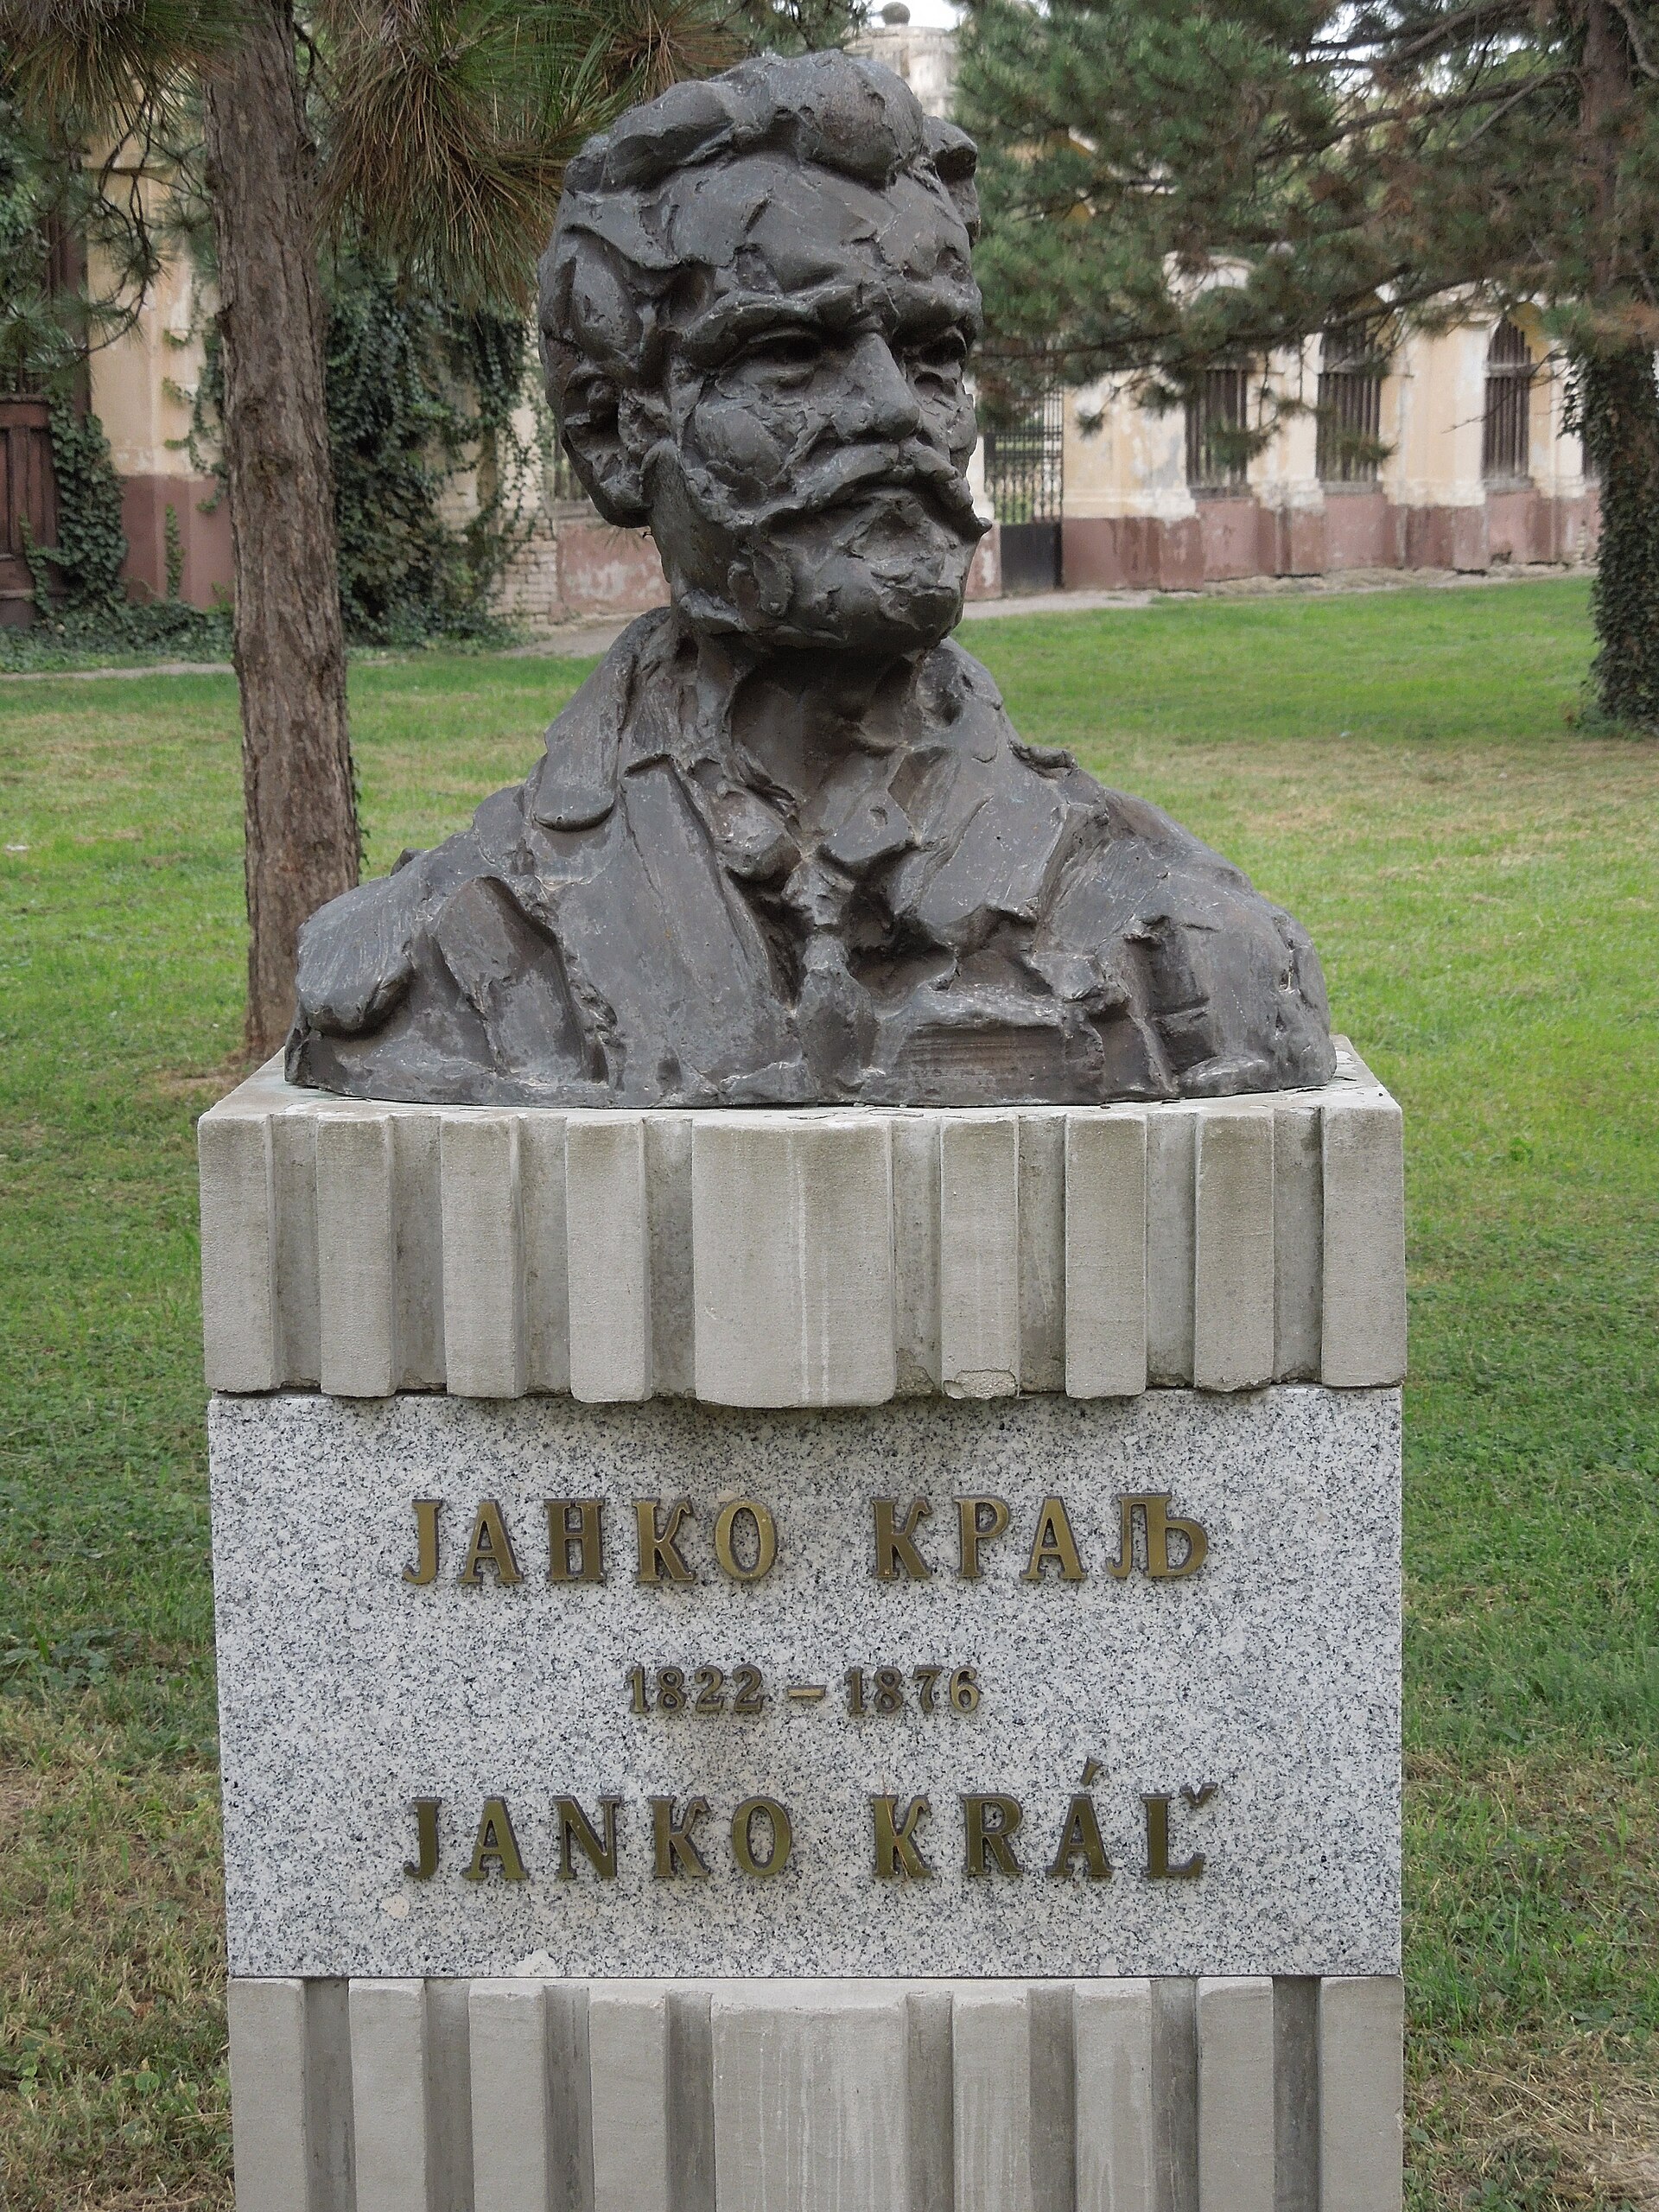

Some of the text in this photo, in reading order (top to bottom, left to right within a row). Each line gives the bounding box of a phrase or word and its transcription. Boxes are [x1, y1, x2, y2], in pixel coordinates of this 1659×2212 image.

[403, 1491, 1211, 1585] ЈАНКО КРАЉ
[626, 1663, 765, 1713] 1822
[843, 1664, 981, 1714] 1876
[403, 1756, 1218, 1880] JANKO KRÁĽ
